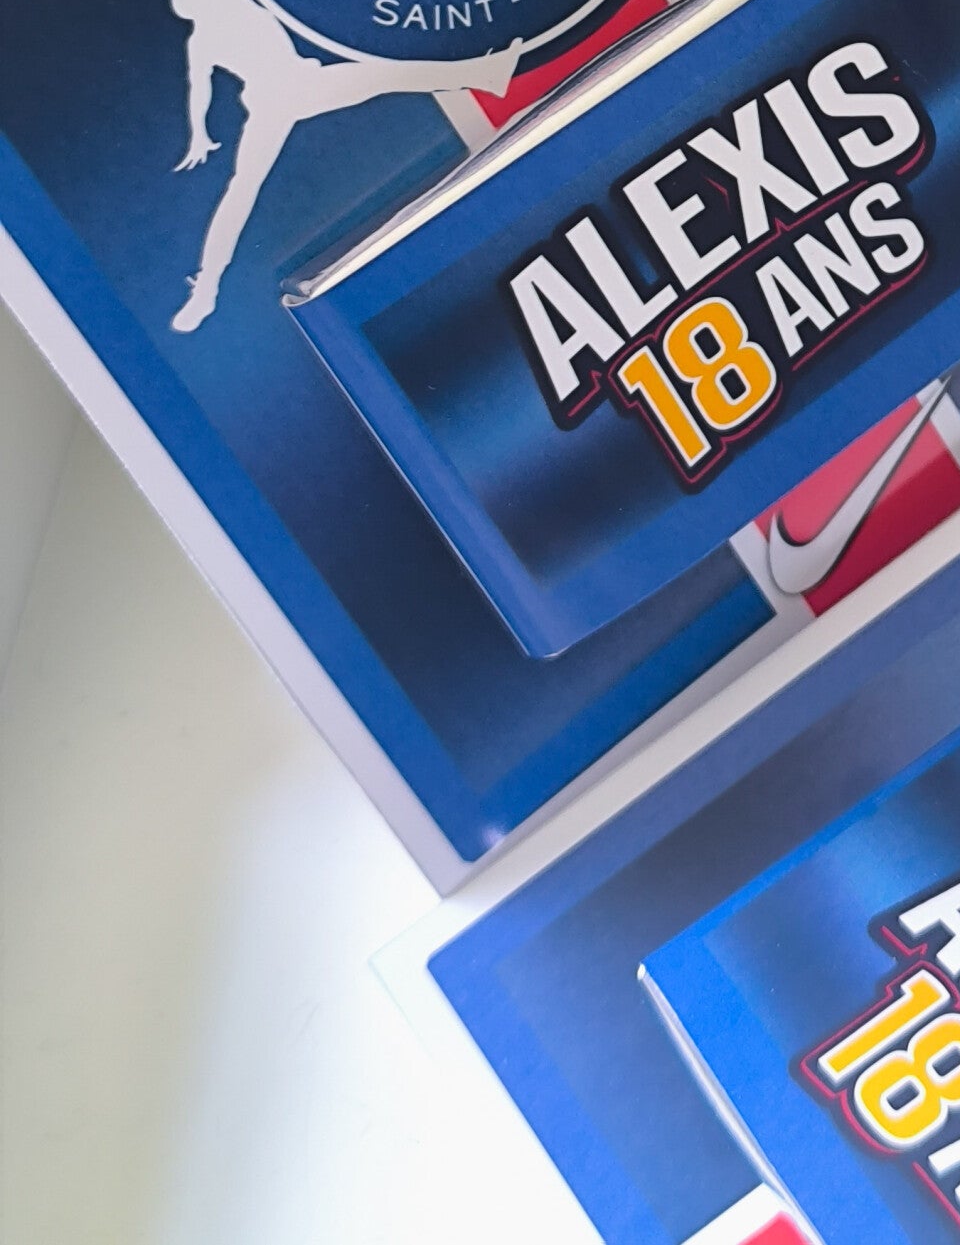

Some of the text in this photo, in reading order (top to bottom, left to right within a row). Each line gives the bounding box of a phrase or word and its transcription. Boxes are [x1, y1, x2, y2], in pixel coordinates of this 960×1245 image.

[509, 42, 920, 401] ALEXIS
[617, 182, 925, 468] 18 ANS
